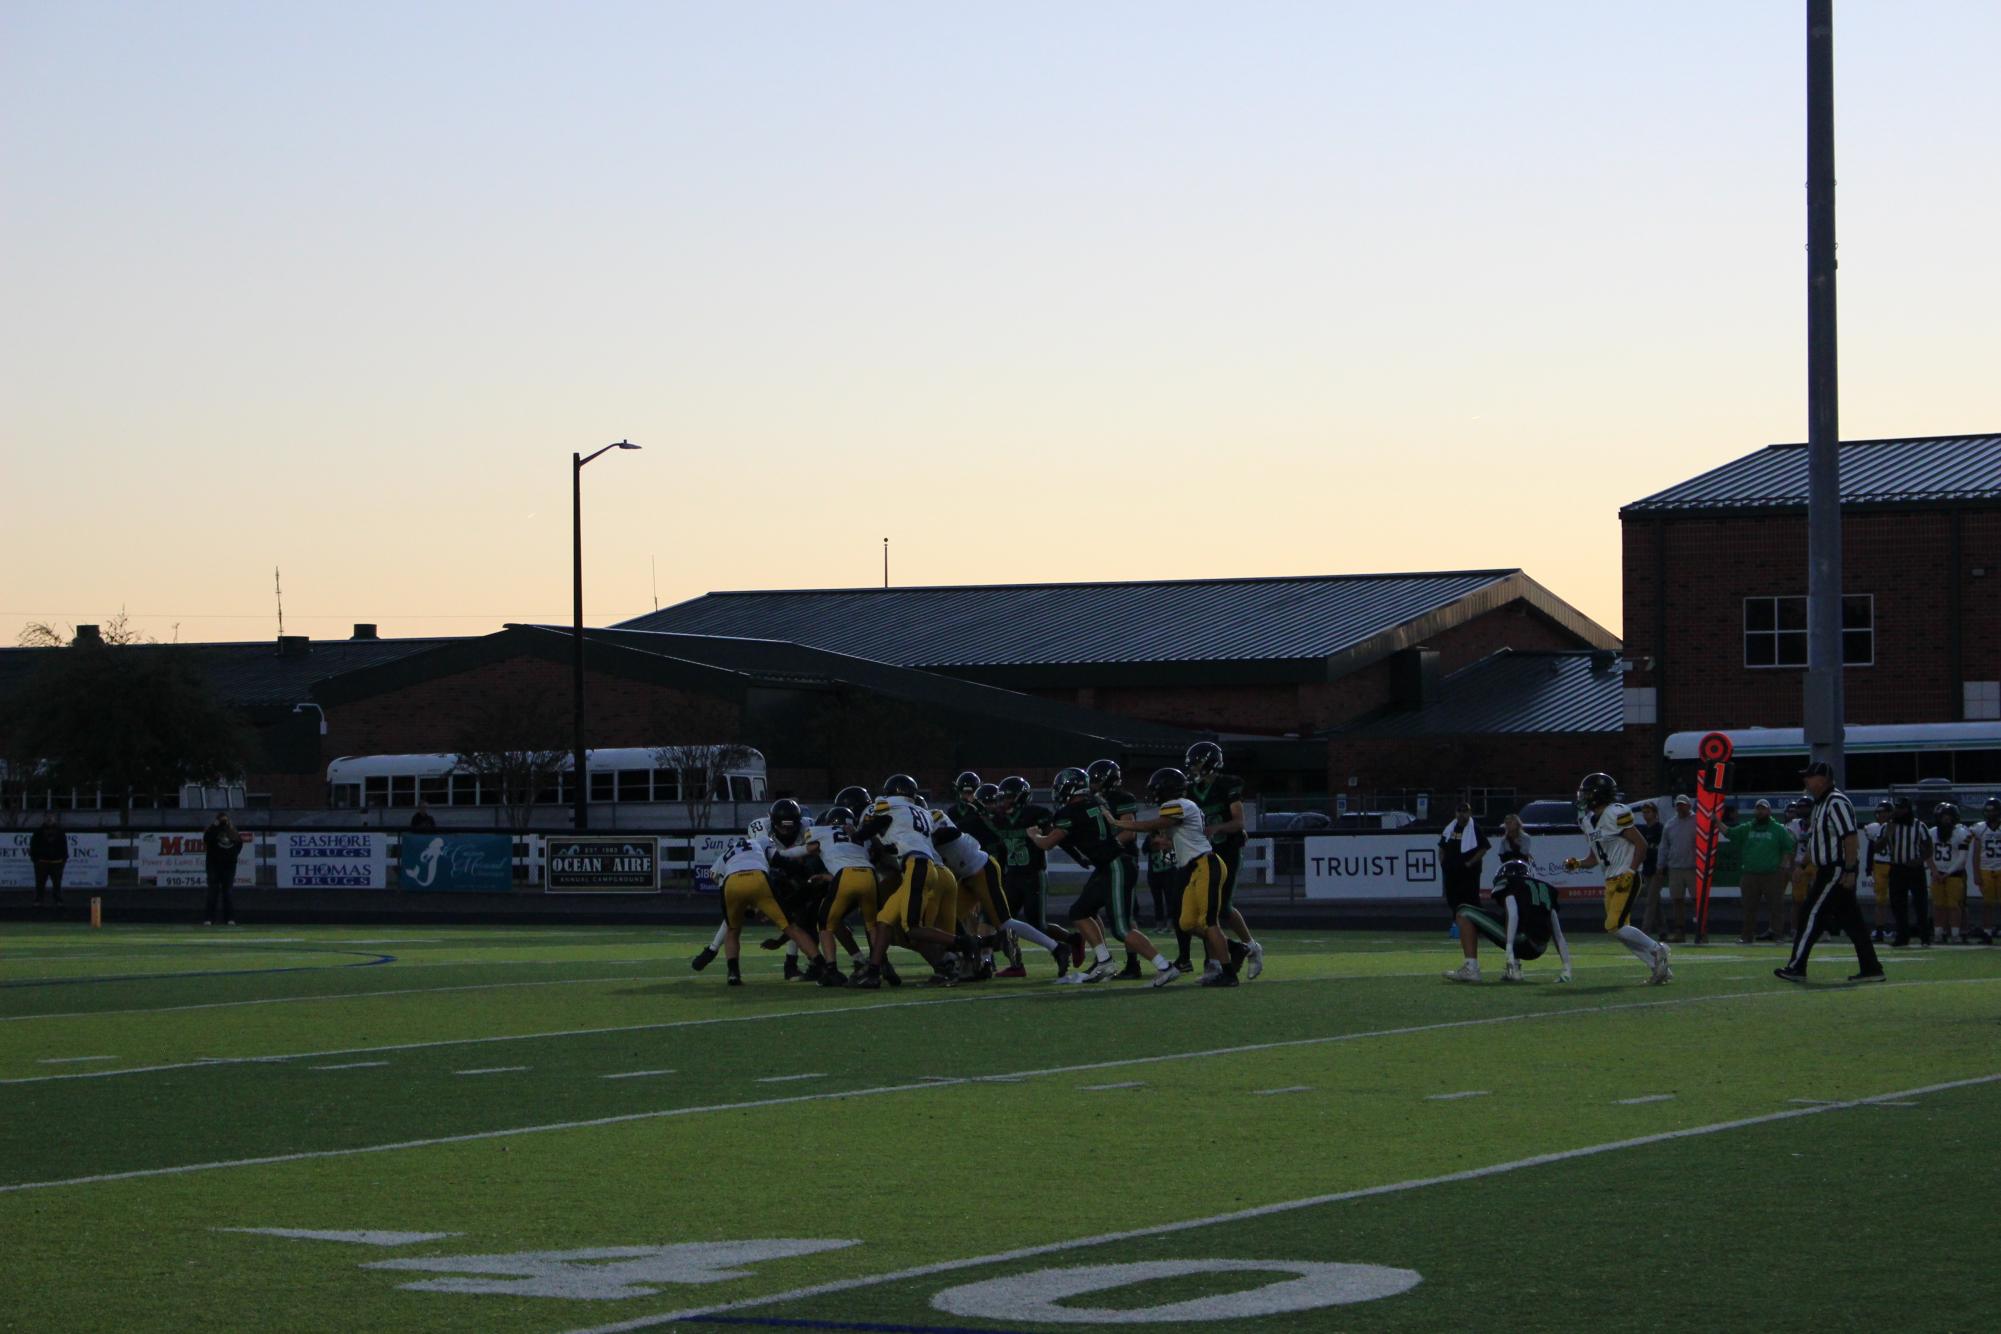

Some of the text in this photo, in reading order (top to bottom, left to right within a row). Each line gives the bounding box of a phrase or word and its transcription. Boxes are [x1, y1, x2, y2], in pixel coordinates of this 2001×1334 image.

[1714, 762, 1725, 790] 1
[909, 806, 929, 837] 81
[290, 835, 371, 847] SEASHORE
[702, 837, 723, 850] Sun
[292, 848, 368, 857] DRUGS
[1934, 843, 1952, 862] 63
[291, 863, 371, 876] THOMAS
[552, 858, 651, 872] OCEAN AIRE
[1311, 856, 1399, 876] TRUIST
[295, 877, 368, 885] DRUGS
